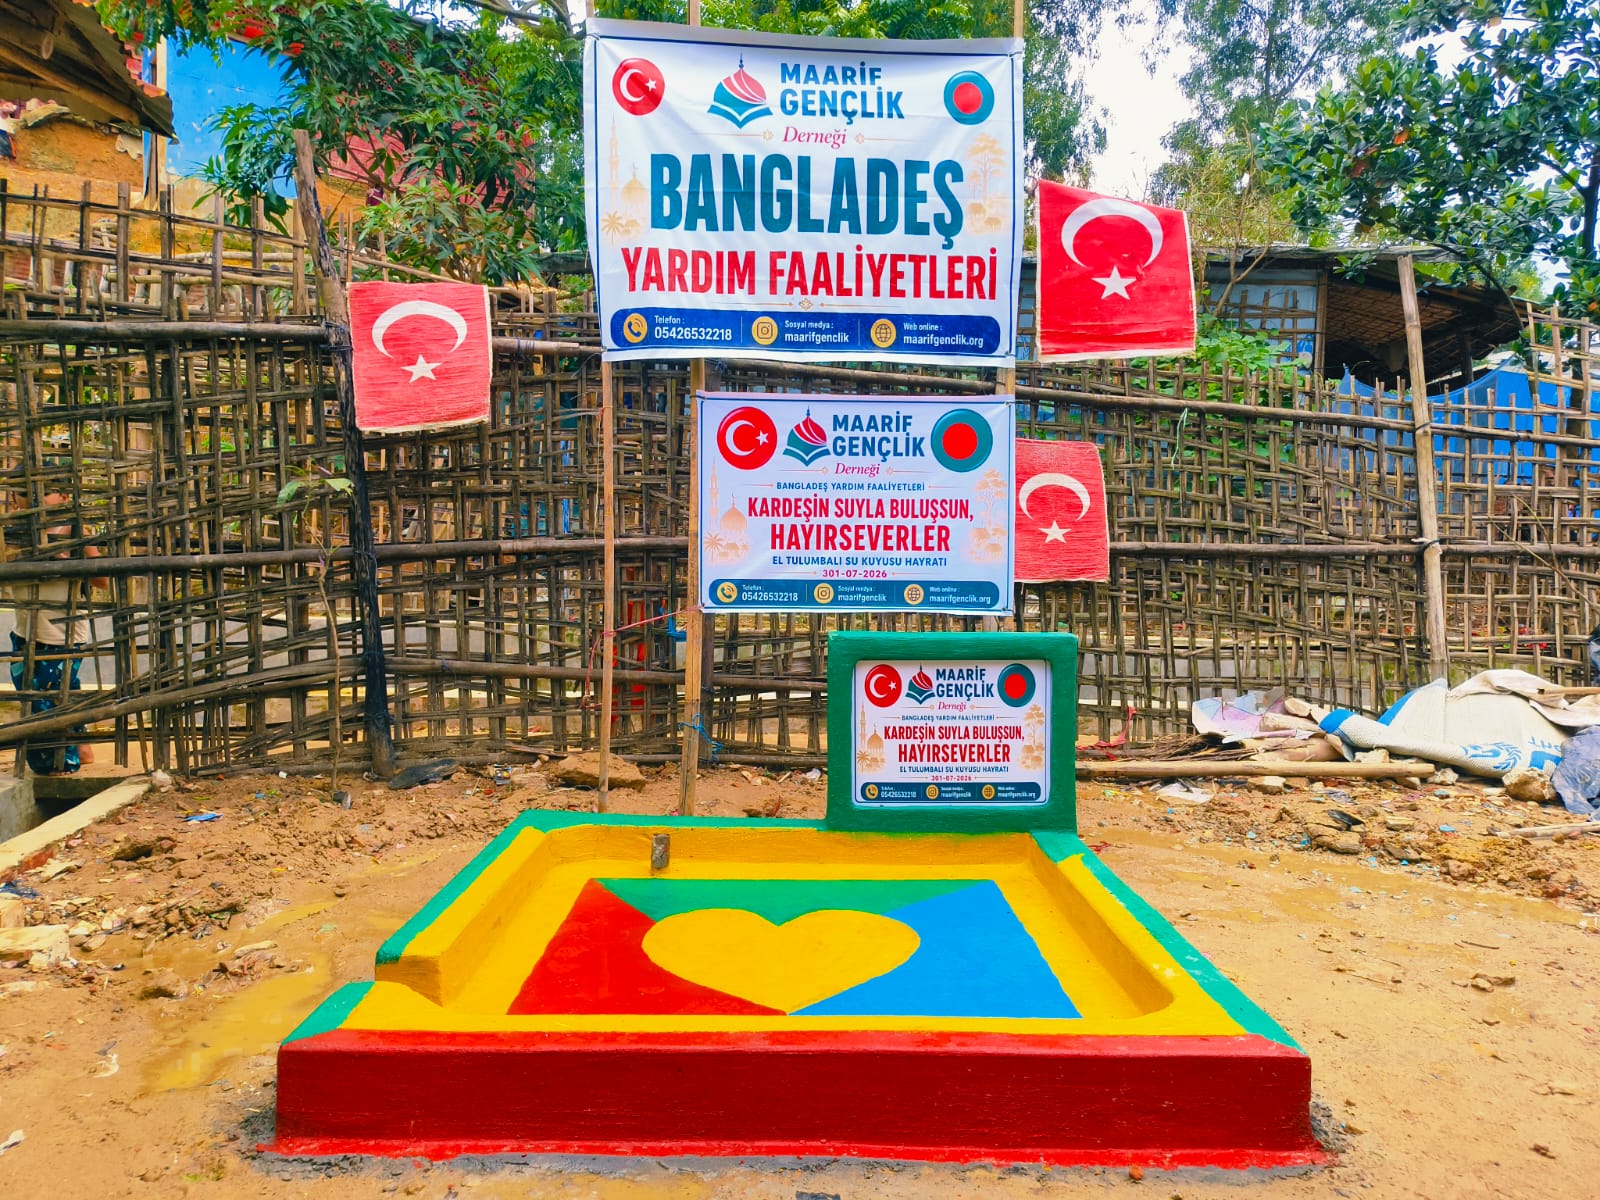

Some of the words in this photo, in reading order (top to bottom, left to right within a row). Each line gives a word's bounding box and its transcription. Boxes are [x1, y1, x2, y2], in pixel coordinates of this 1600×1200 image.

[780, 61, 882, 86] MAARİF
[779, 86, 905, 125] GENÇLİK
[783, 126, 848, 150] Derneği
[650, 153, 964, 250] BANGLADEŞ
[621, 247, 756, 296] YARDIM
[769, 244, 998, 300] FAALİYETLERİ
[654, 315, 681, 324] Telefon
[785, 320, 807, 329] Sosyal
[808, 321, 830, 331] medya
[903, 322, 917, 331] Web
[919, 323, 939, 331] online
[655, 326, 732, 341] 05426532218
[785, 331, 849, 344] maarifgenclik
[903, 334, 984, 348] maarifgenclik.org
[833, 410, 913, 433] MAARİF
[832, 433, 926, 462] GENÇLİK
[835, 463, 881, 477] Derneği
[776, 481, 828, 492] BANGLADEŞ
[831, 482, 865, 491] YARDIM
[867, 481, 925, 492] FAALİYETLERİ
[748, 493, 829, 523] KARDEŞİN
[834, 498, 885, 519] SUYLA
[890, 498, 974, 523] BULUŞSUN,
[770, 523, 951, 551] HAYIRSEVERLER
[772, 556, 783, 565] EL
[786, 556, 842, 566] TULUMBALI
[845, 556, 858, 566] SU
[861, 557, 902, 566] KUYUSU
[905, 557, 948, 567] HAYRATI
[822, 569, 888, 579] 301-07-2026
[741, 592, 798, 601] 05426532218
[838, 593, 887, 603] maarifgenclik
[936, 665, 987, 681] MAARİF
[936, 681, 994, 701] GENÇLİK
[938, 701, 967, 712] Derneği
[884, 723, 935, 743] KARDEŞİN
[938, 726, 970, 740] SUYLA
[973, 726, 1025, 743] BULUŞSUN,
[898, 744, 1011, 763] HAYIRSEVERLER
